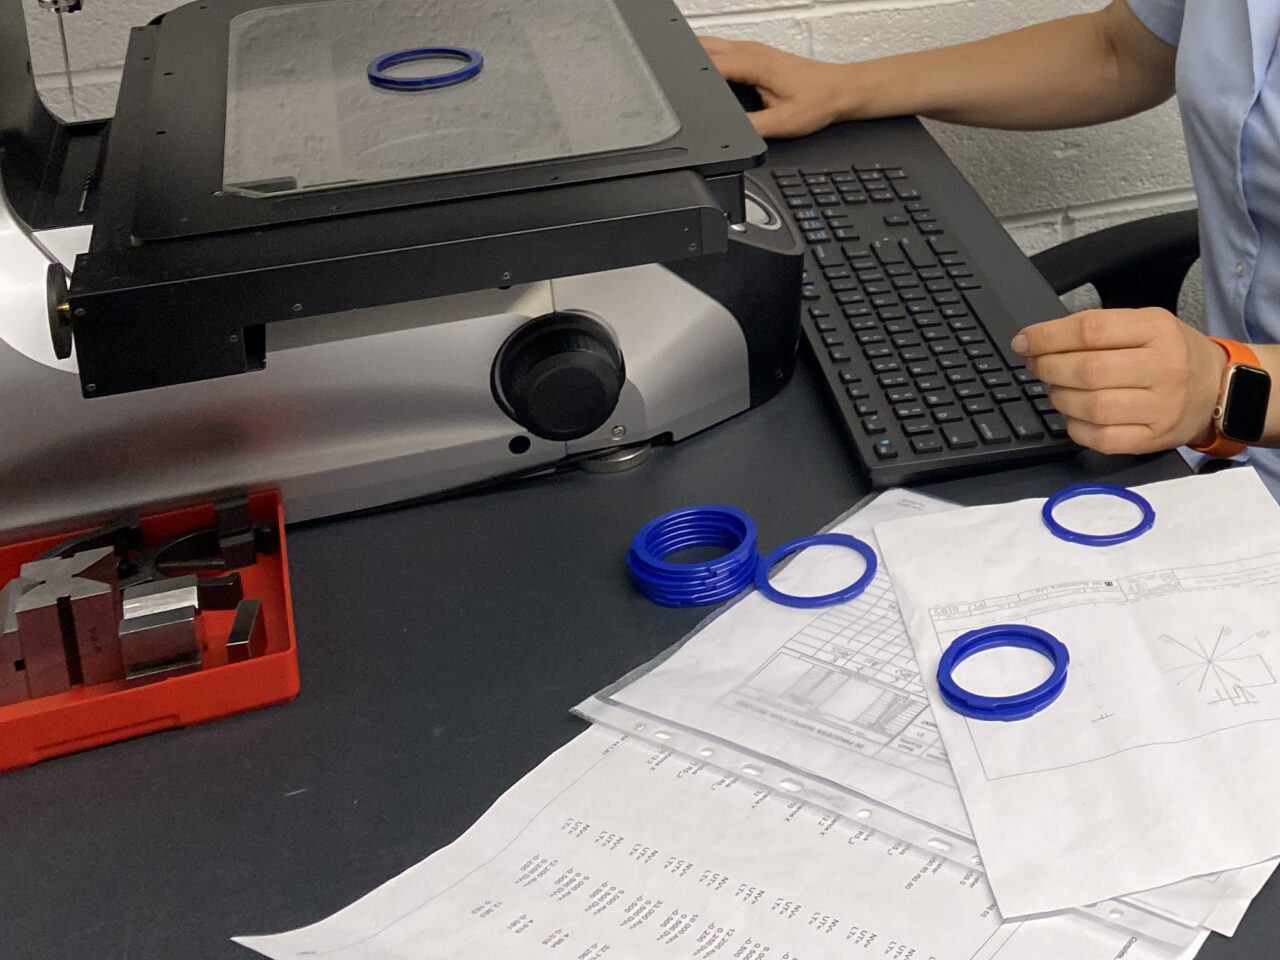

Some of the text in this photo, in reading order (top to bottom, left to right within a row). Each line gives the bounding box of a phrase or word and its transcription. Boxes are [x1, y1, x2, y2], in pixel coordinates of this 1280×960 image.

[698, 869, 711, 882] LT=
[706, 873, 720, 886] UT=
[714, 876, 728, 890] NV=
[734, 883, 747, 896] LT=
[742, 886, 756, 901] UT=
[751, 890, 765, 904] NV=
[771, 897, 783, 910] LT=
[779, 901, 792, 914] UT=
[787, 904, 801, 918] NV=
[807, 911, 820, 924] LT=
[816, 915, 830, 929] UT=
[825, 918, 839, 933] NV=
[845, 926, 858, 939] LT=
[854, 929, 868, 943] UT=
[863, 933, 877, 947] NV=
[884, 941, 896, 954] LT=
